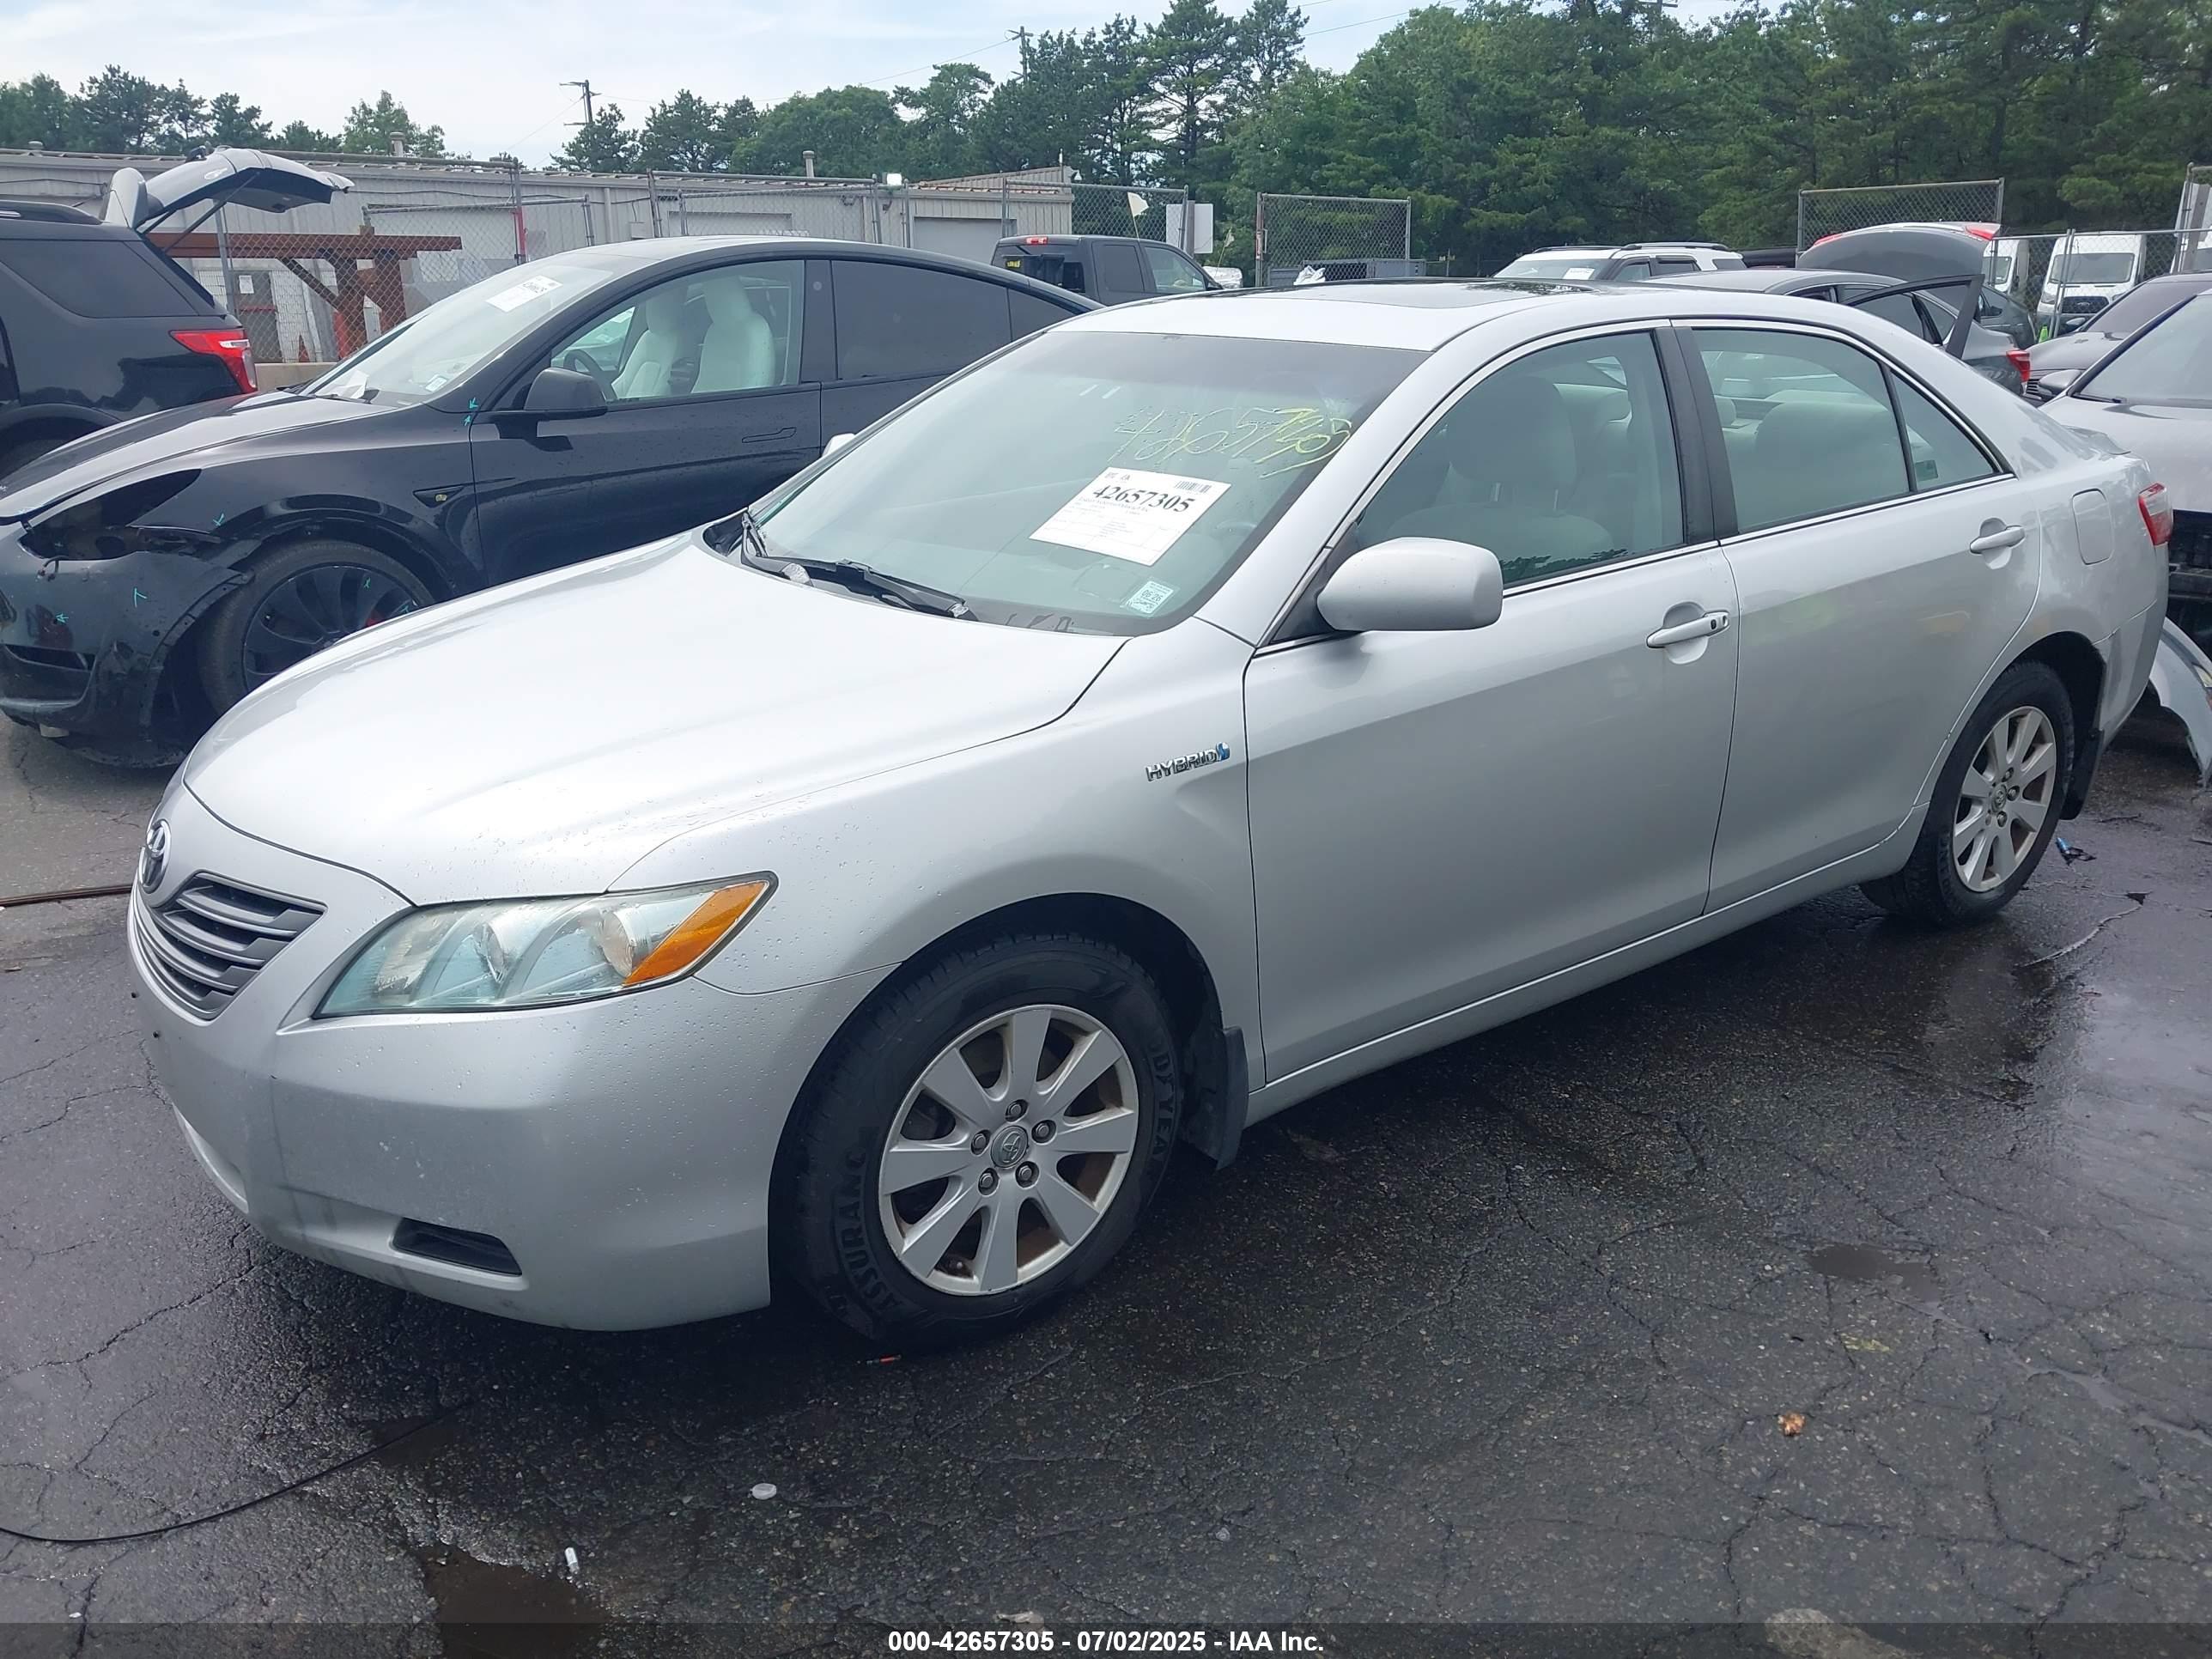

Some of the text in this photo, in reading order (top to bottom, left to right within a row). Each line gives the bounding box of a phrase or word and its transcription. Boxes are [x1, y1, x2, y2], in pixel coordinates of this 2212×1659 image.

[1091, 484, 1196, 513] 42657305
[1145, 748, 1217, 782] HYBRID
[837, 1140, 905, 1312] ASSURANC
